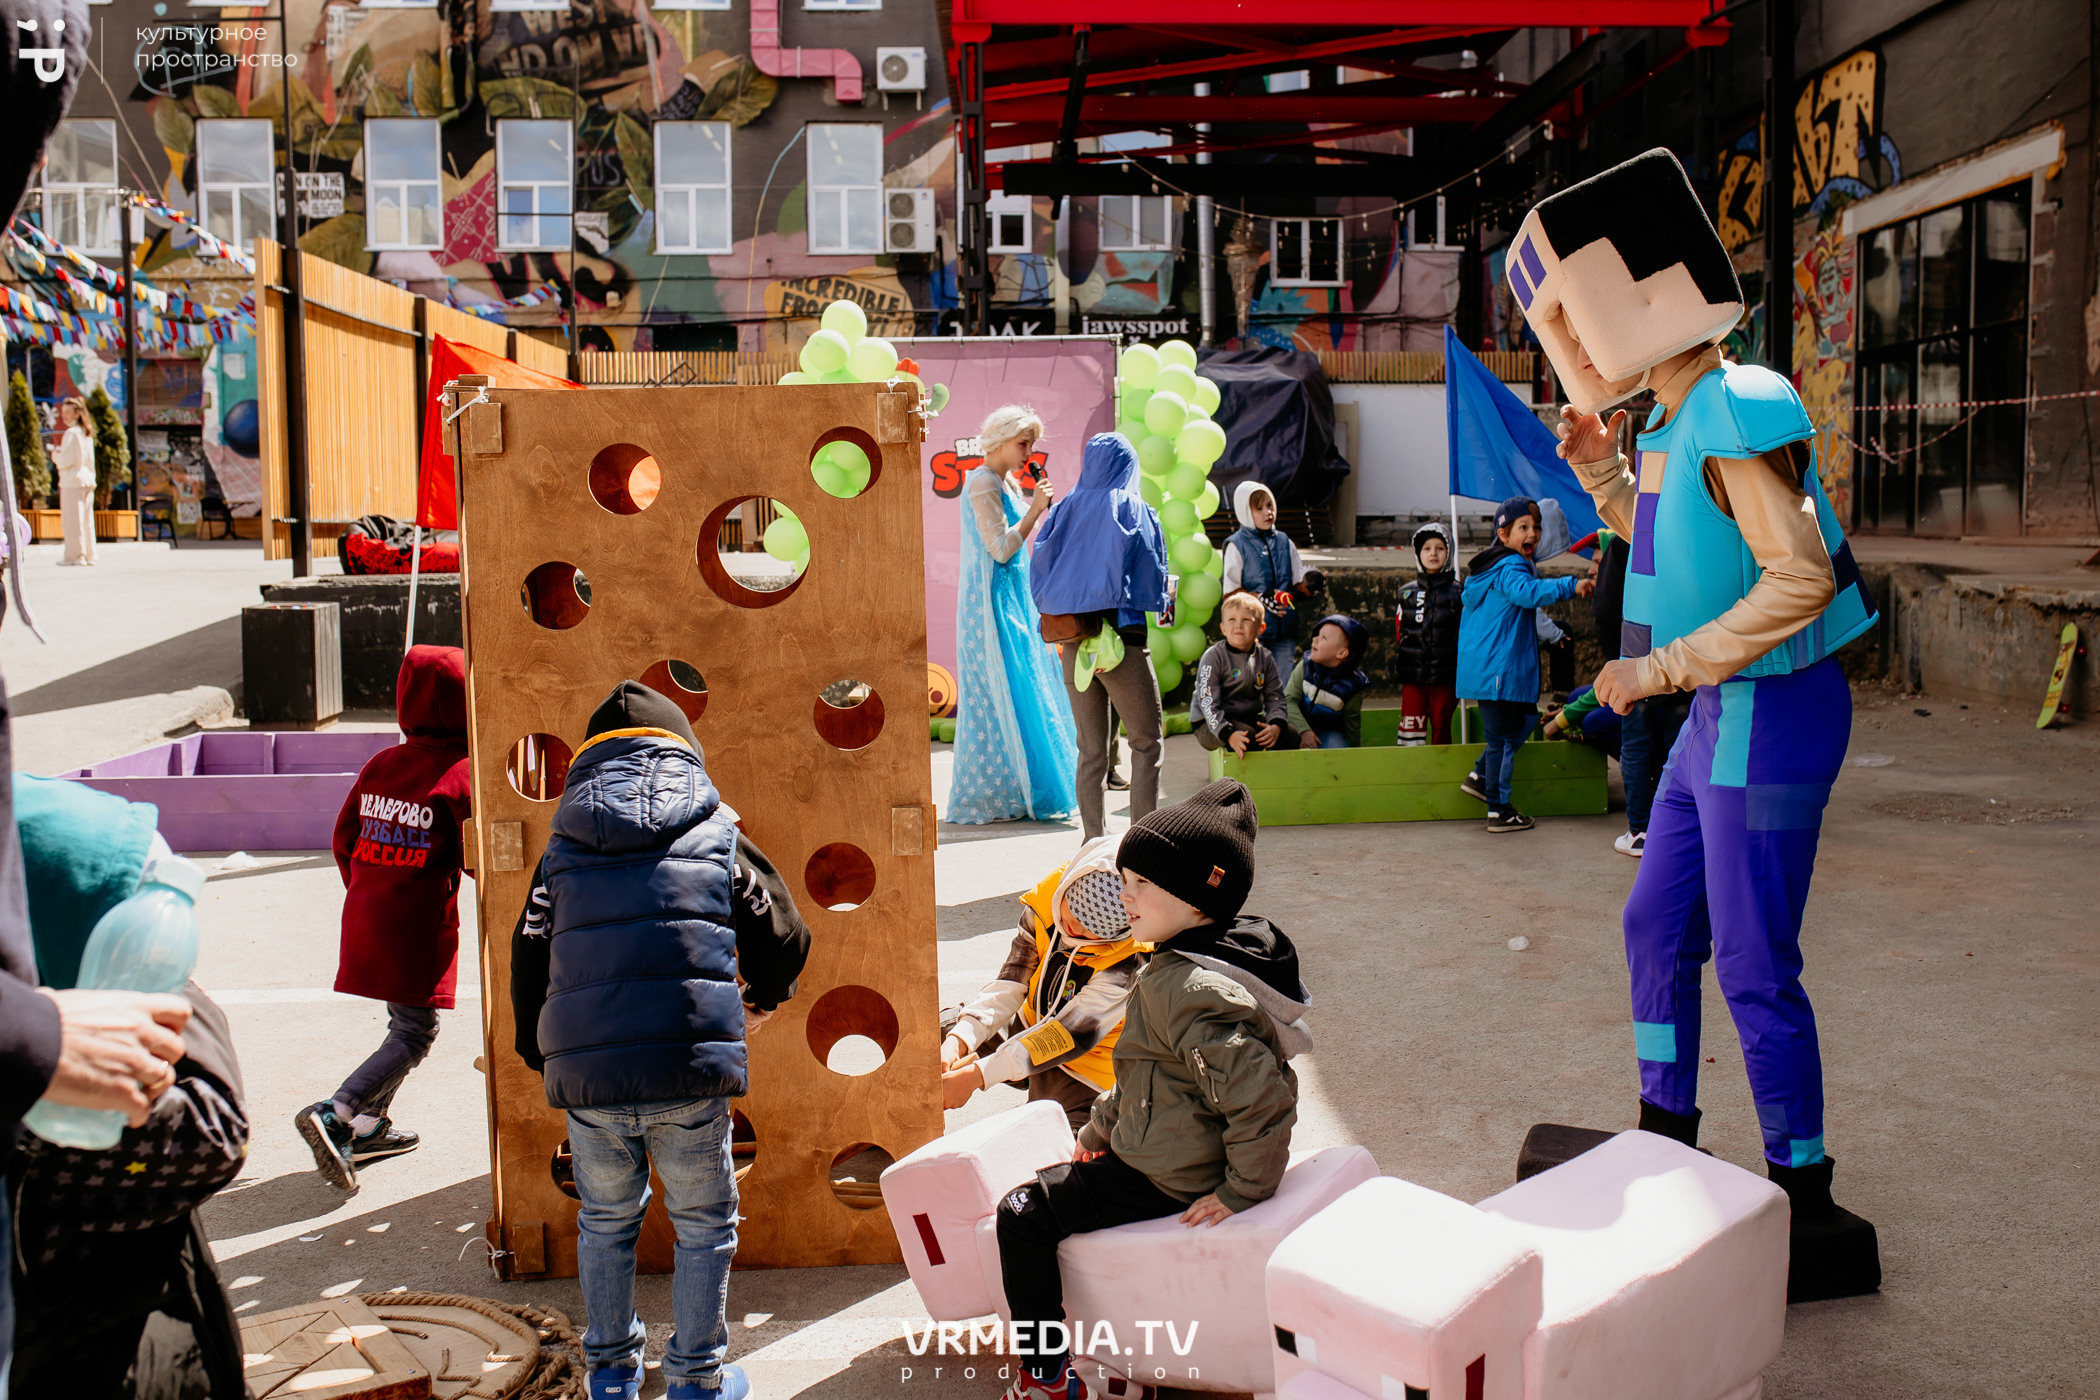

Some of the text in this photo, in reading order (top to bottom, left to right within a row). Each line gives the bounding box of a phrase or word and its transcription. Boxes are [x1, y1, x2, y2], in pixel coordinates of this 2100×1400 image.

[1082, 316, 1190, 339] jawsspot
[1400, 715, 1426, 730] EY
[360, 793, 434, 830] КЕМЕРОВО
